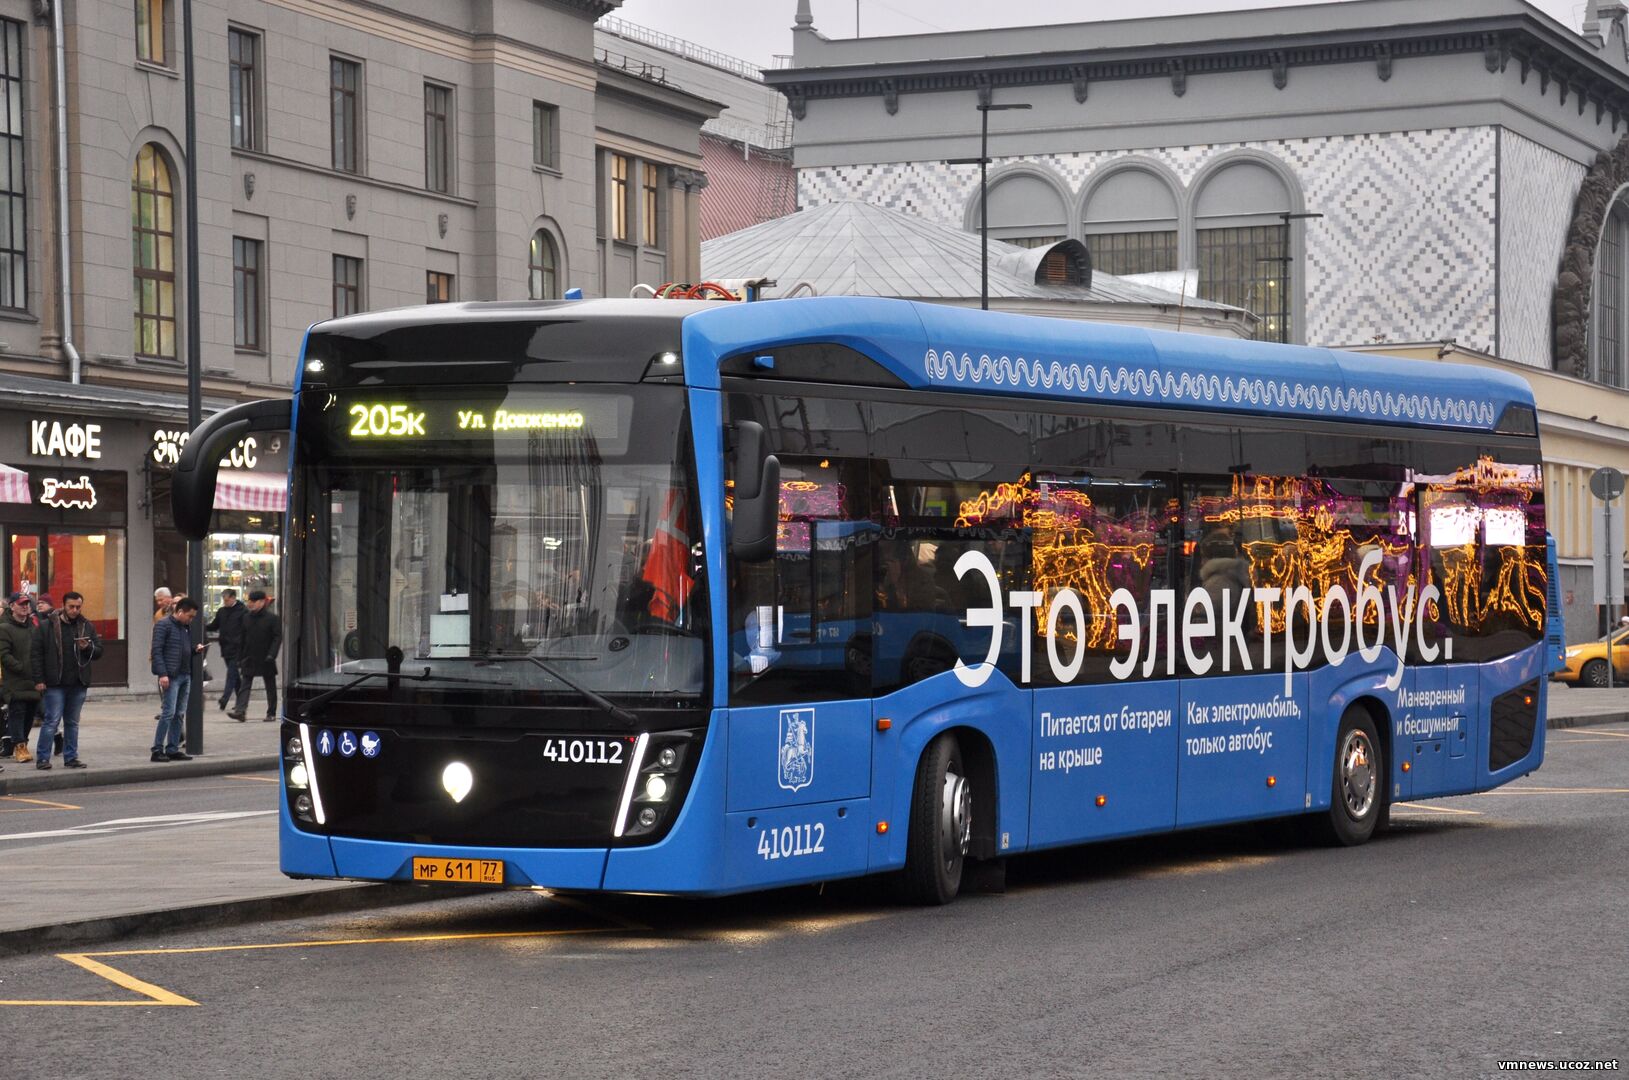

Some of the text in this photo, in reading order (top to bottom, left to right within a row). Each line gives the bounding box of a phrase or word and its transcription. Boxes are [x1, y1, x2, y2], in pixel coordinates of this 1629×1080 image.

[458, 410, 584, 431] Ул. Довженко
[31, 419, 102, 458] КАФЕ
[952, 547, 1454, 698] Это электробус.
[1187, 694, 1301, 726] Как электромобиль,
[1397, 684, 1465, 711] Маневренный
[1040, 705, 1172, 738] Питается от батареи
[1396, 711, 1459, 738] и бесшумный
[542, 738, 623, 764] 410112
[1186, 725, 1273, 756] только автобус
[1039, 746, 1103, 774] на крыше
[756, 822, 825, 861] 410112
[420, 861, 498, 880] МР 611 77
